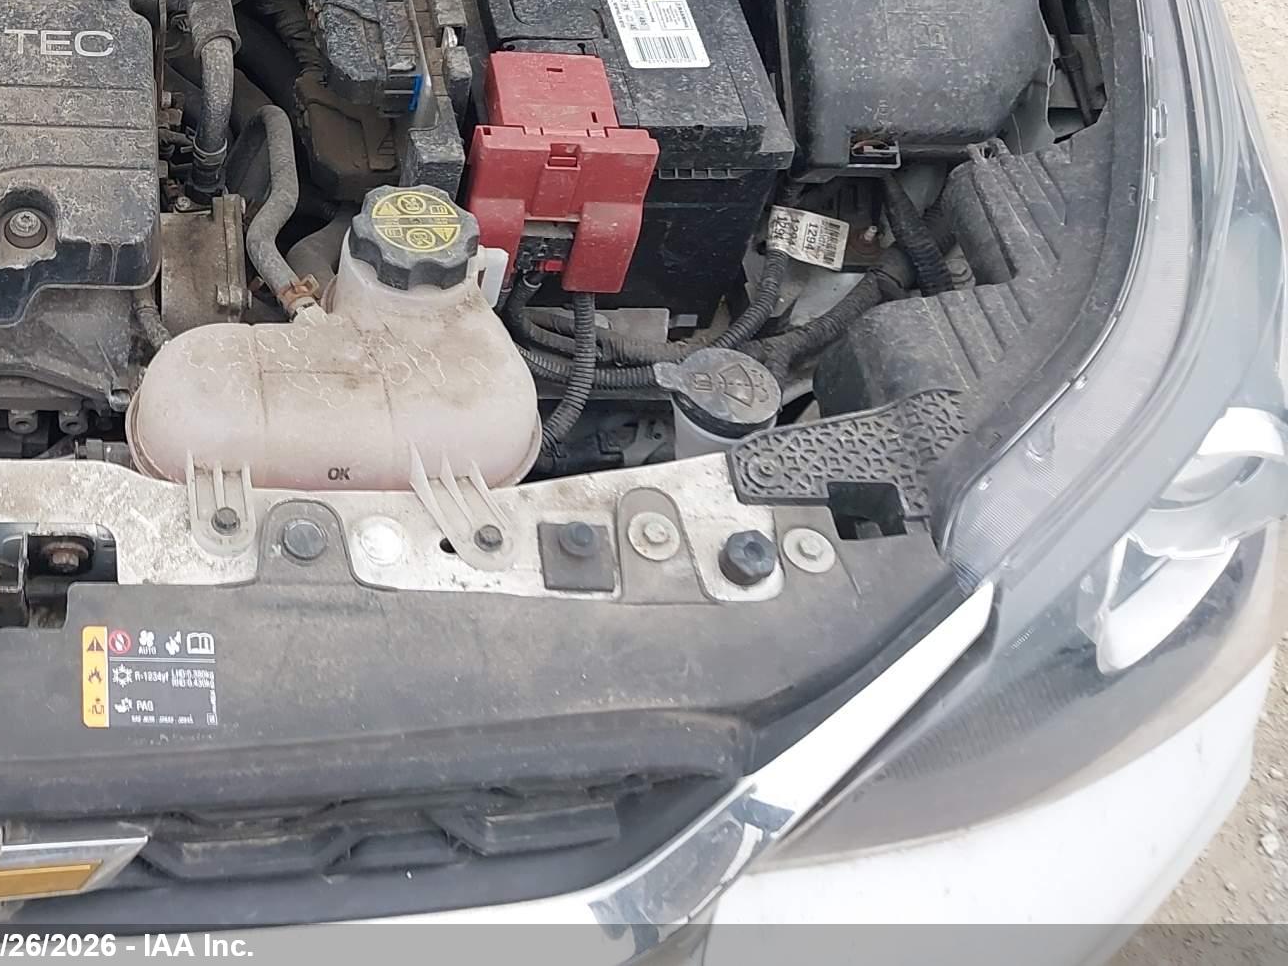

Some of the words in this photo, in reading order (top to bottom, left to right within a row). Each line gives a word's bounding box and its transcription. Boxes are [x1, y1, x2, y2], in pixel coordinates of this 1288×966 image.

[804, 222, 819, 250] 1294
[328, 467, 350, 481] OK
[138, 645, 157, 655] AUTO
